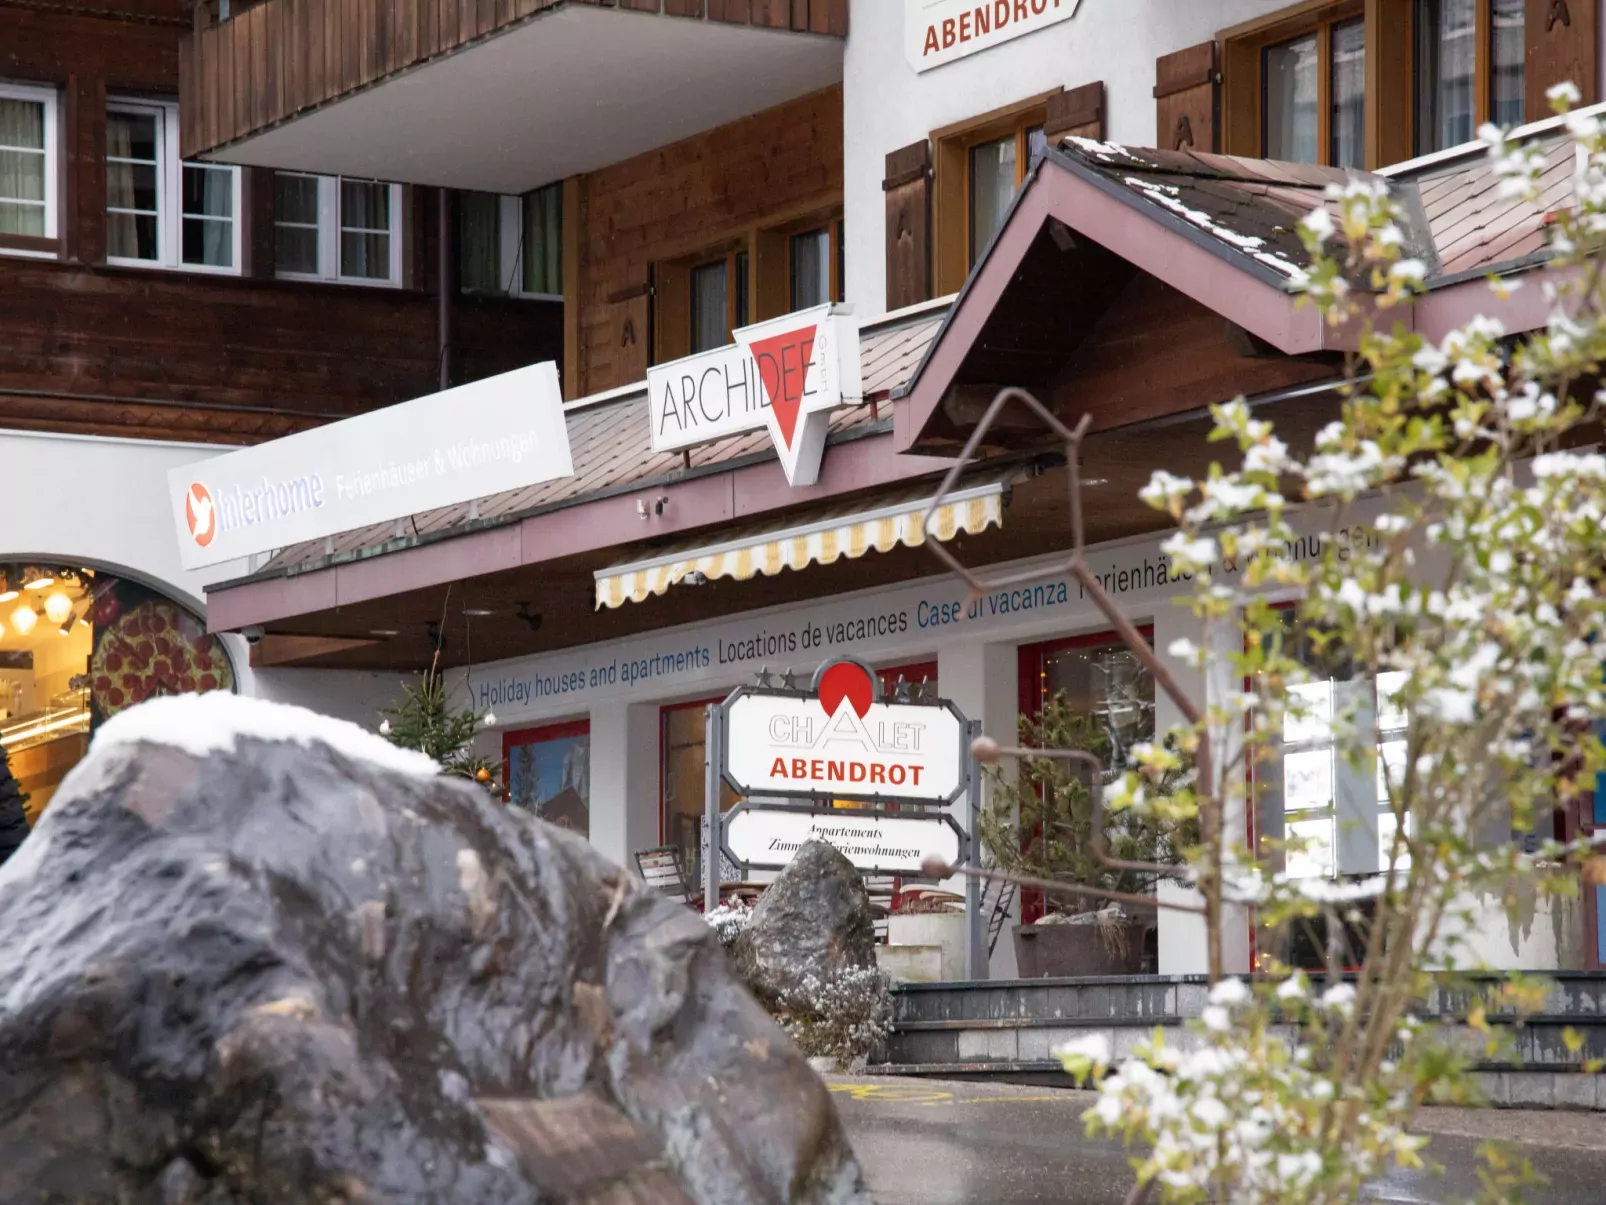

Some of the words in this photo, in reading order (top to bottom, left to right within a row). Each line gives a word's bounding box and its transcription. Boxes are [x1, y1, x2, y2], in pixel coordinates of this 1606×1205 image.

[922, 0, 1061, 57] ABENDRO
[659, 337, 818, 436] ARCHIDEE
[214, 471, 324, 532] Interhome
[336, 457, 430, 500] Ferienhäuser
[432, 448, 447, 475] &
[447, 428, 540, 470] Wohnungen
[479, 679, 531, 707] Holiday
[535, 670, 586, 698] houses
[589, 658, 616, 686] and
[621, 645, 709, 687] apartments
[718, 629, 797, 665] Locations
[802, 621, 822, 649] de
[825, 610, 908, 646] vacances
[917, 599, 962, 629] Case
[988, 581, 1068, 616] vacanza
[1079, 556, 1212, 600] rienhä
[1247, 525, 1380, 564] nugen
[768, 693, 927, 752] CHALET
[769, 756, 925, 787] ABENDROT
[767, 837, 802, 852] Zimm
